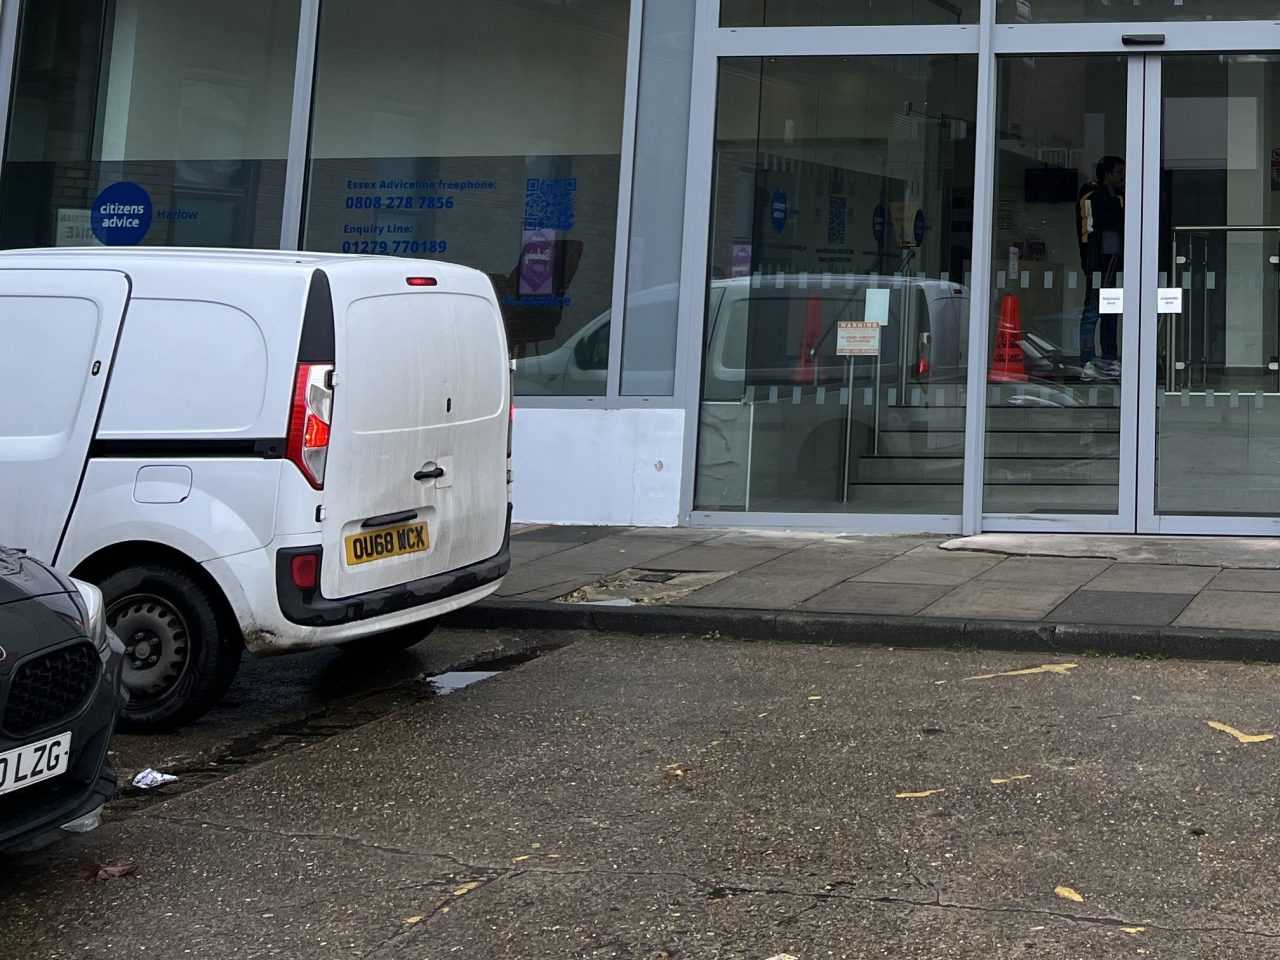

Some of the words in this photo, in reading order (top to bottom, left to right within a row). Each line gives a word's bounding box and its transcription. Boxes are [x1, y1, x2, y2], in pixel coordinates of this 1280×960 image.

[347, 180, 377, 190] Essex
[379, 180, 436, 190] Adviceline
[438, 180, 497, 192] freephone:
[100, 202, 145, 215] citizens
[345, 196, 382, 209] 0808
[386, 196, 413, 209] 278
[418, 196, 454, 209] 7856
[157, 208, 198, 220] Harlow
[102, 216, 140, 228] advice
[343, 224, 384, 236] Enquiry
[387, 224, 414, 234] Line:
[342, 240, 388, 254] 01279
[393, 240, 447, 254] 770189
[352, 531, 394, 560] OU68
[13, 740, 62, 783] LZG
